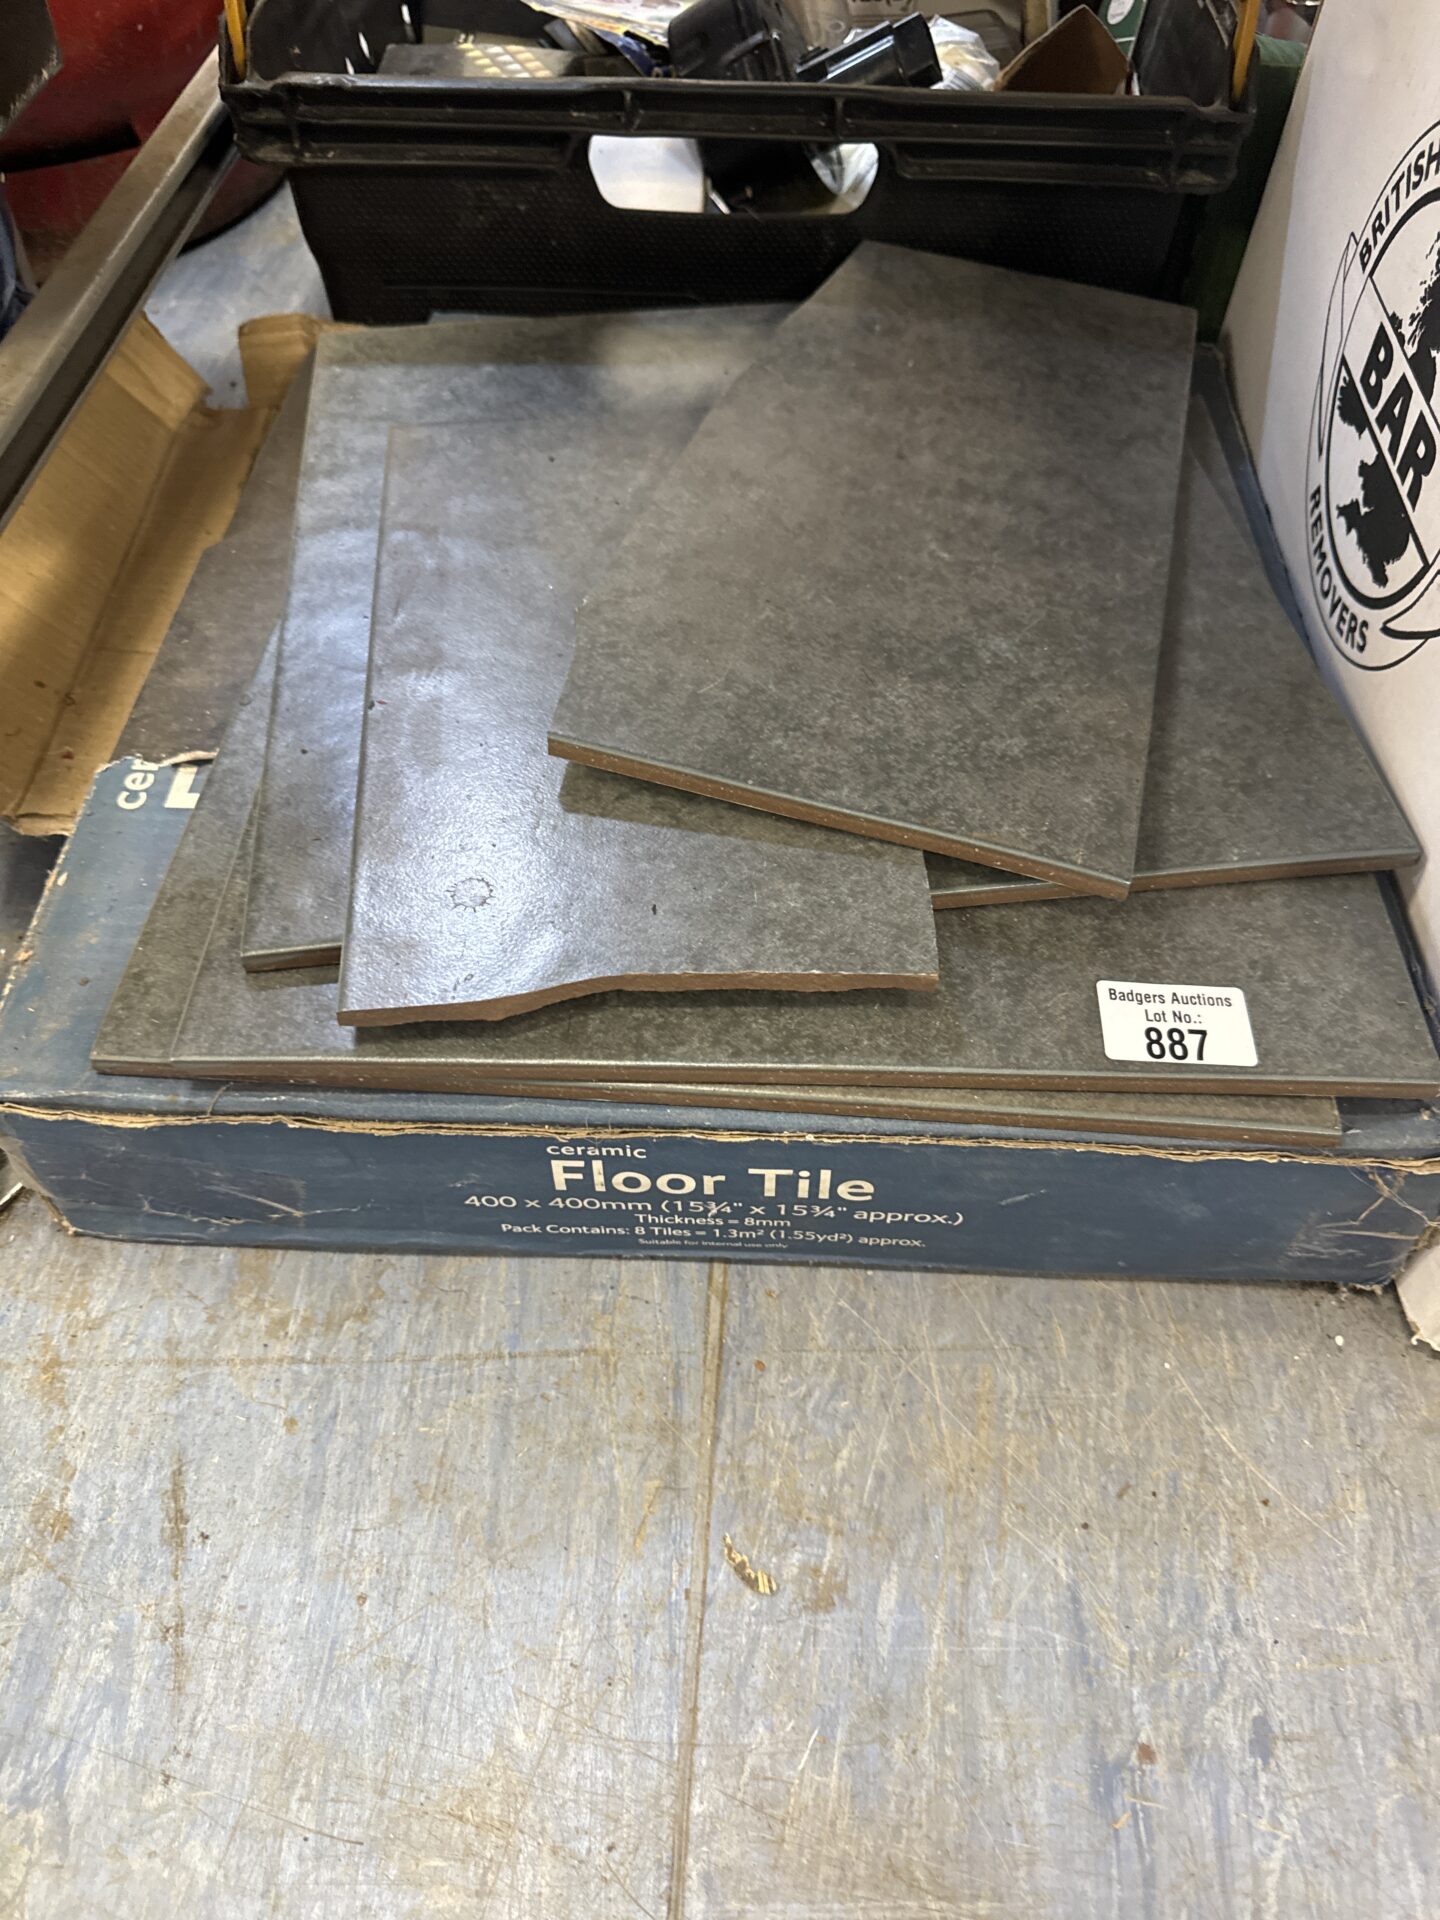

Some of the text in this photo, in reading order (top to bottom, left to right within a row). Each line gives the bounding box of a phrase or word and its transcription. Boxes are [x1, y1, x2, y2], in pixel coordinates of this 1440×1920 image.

[1359, 138, 1440, 275] BRITISH
[1360, 321, 1437, 513] BAR
[1310, 484, 1369, 653] REMOVERS
[1108, 987, 1232, 1007] Badgers Auctions
[1145, 1009, 1202, 1025] Lot No.:
[1144, 1026, 1208, 1061] 887
[546, 1145, 647, 1159] ceramic
[550, 1160, 875, 1201] Floor Tile
[464, 1195, 517, 1208] 400
[525, 1199, 542, 1208] x
[548, 1197, 652, 1211] 400mm
[750, 1206, 766, 1215] x
[853, 1209, 964, 1226] approx.)
[633, 1213, 727, 1226] Thickness
[744, 1217, 791, 1227] 8mm
[501, 1223, 543, 1234] Pack
[545, 1224, 630, 1236] Contains:
[634, 1226, 646, 1236] 8
[650, 1226, 692, 1237] Tiles
[858, 1235, 926, 1248] approx.
